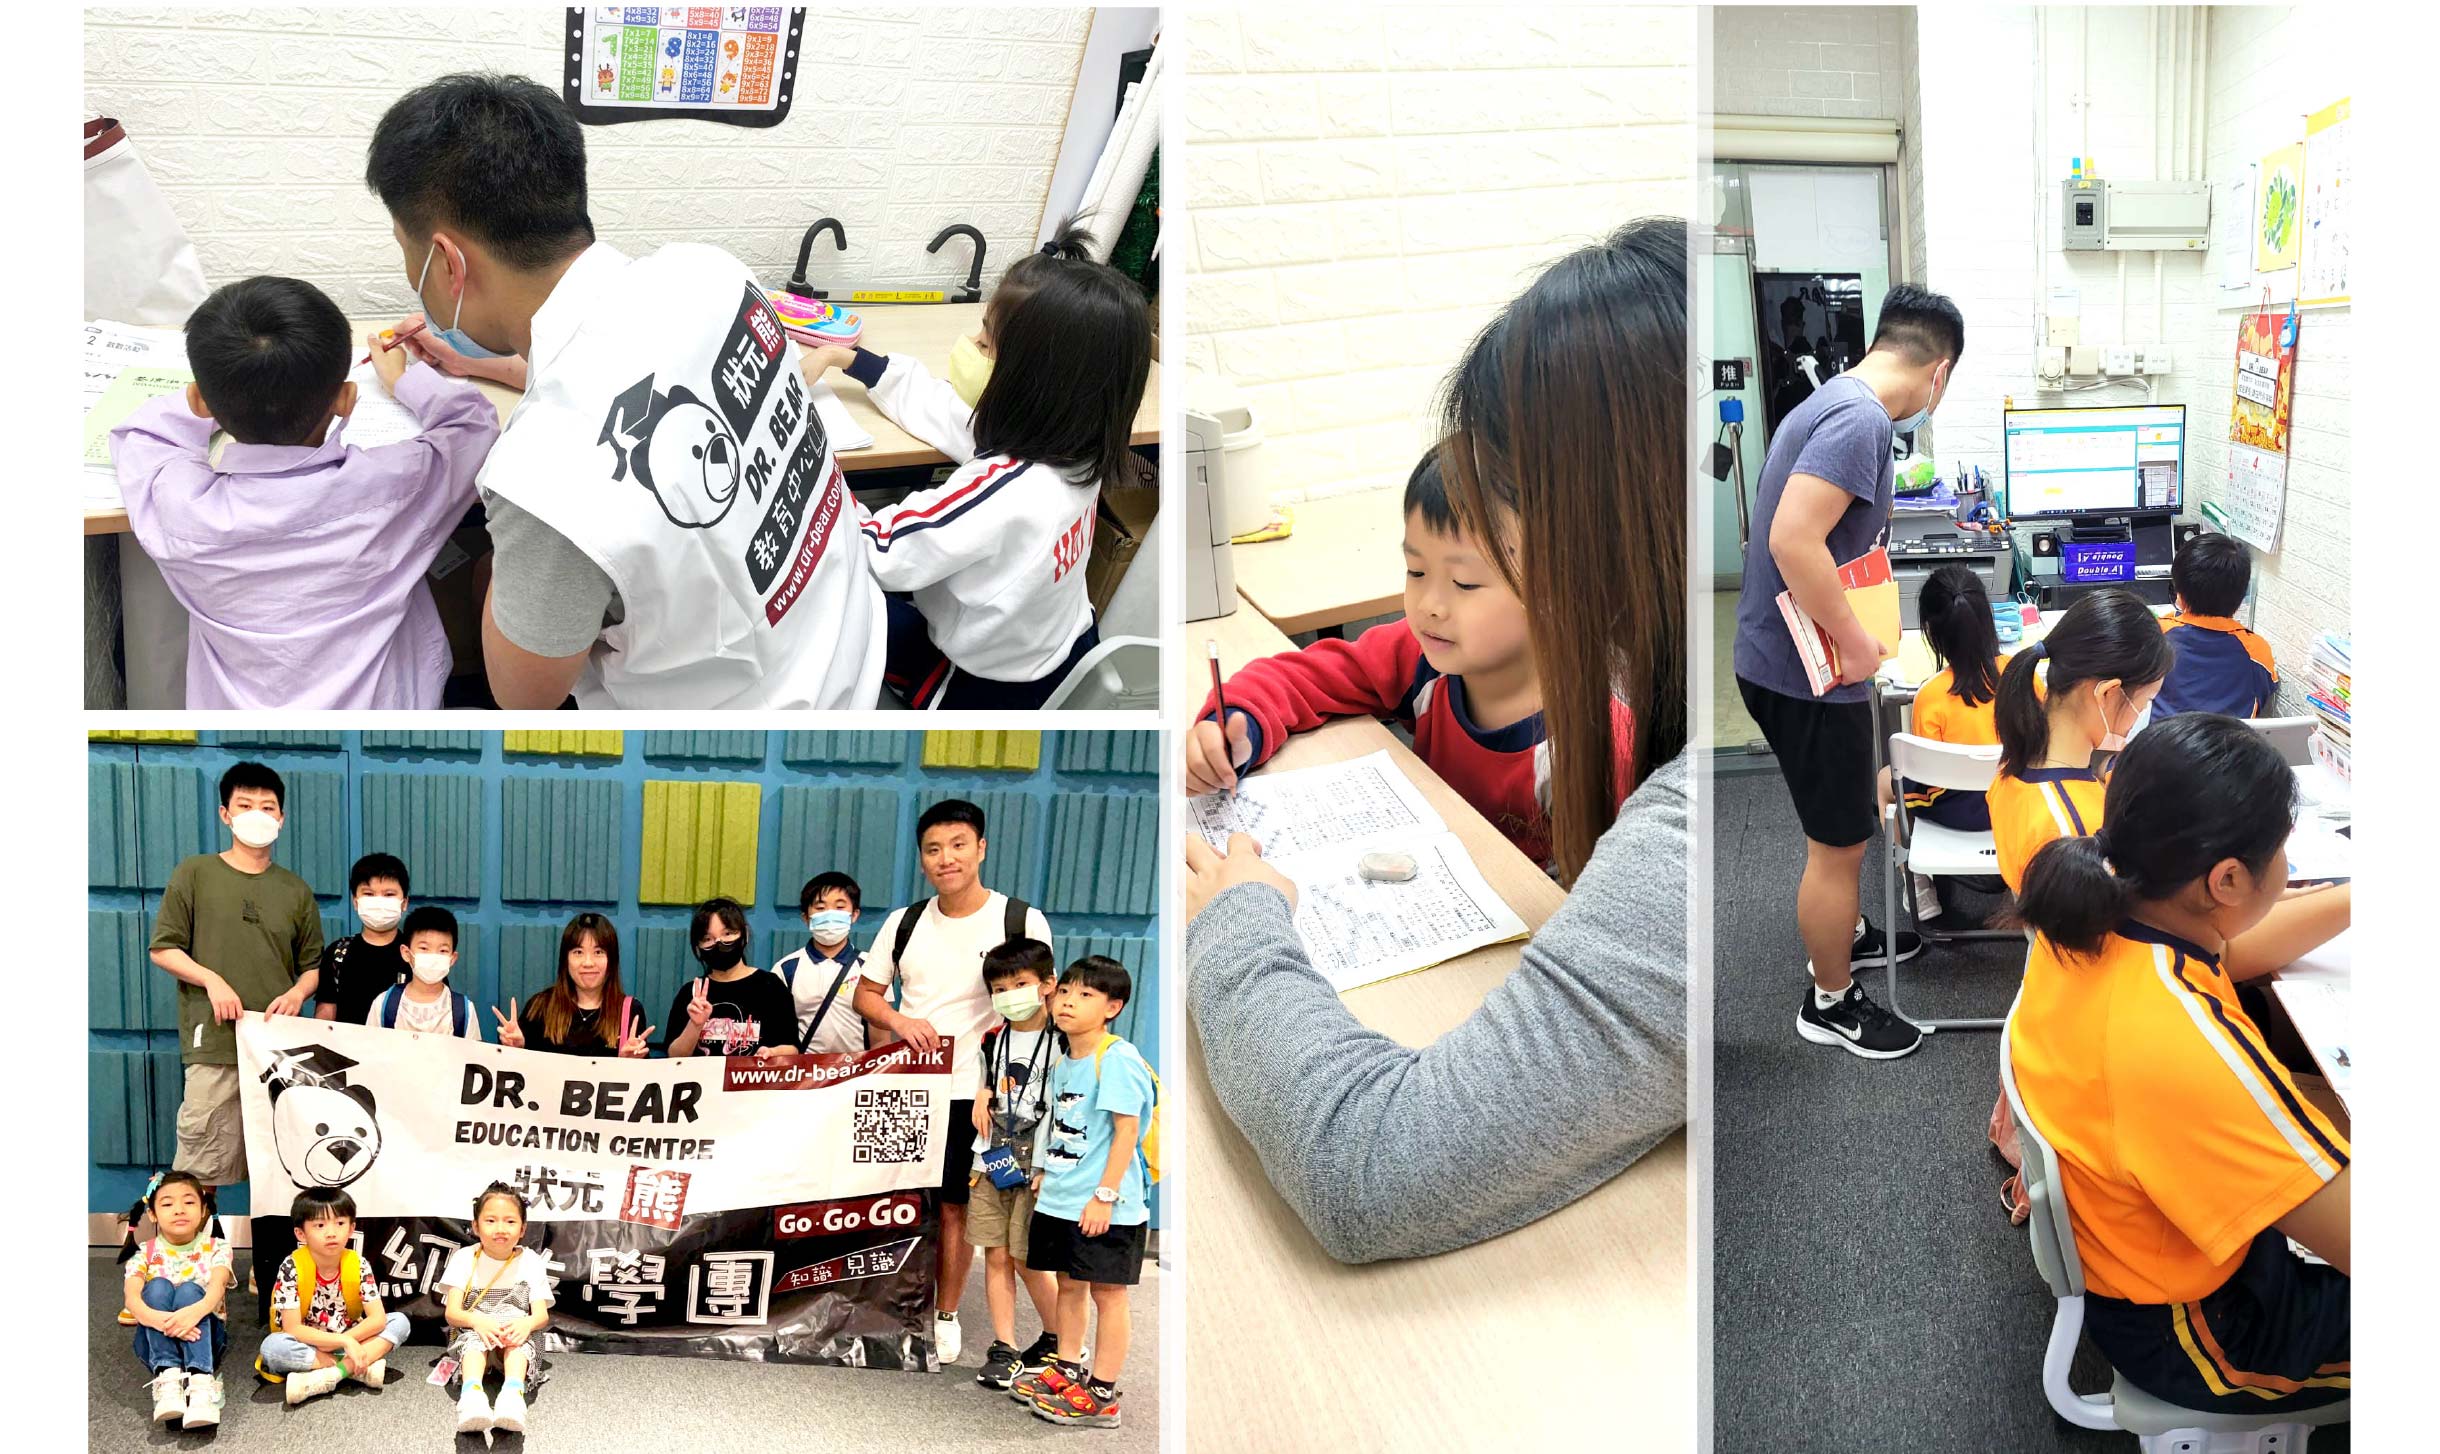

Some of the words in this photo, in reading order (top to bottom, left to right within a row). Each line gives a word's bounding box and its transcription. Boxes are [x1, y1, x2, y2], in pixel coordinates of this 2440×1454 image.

[625, 8, 657, 16] 4x8=32
[625, 15, 657, 23] 4x9=36
[624, 29, 651, 37] 7x1=7
[686, 40, 716, 48] 8x2=16
[1721, 364, 1737, 382] 推
[745, 446, 777, 504] DR.
[769, 372, 803, 452] BEAR
[753, 445, 814, 572] 教育中心
[2078, 566, 2109, 574] Double
[2111, 565, 2118, 573] A
[461, 1063, 540, 1111] DR.
[560, 1080, 702, 1124] BEAR
[455, 1121, 600, 1154] EDUCATION
[609, 1135, 715, 1160] CENTRE
